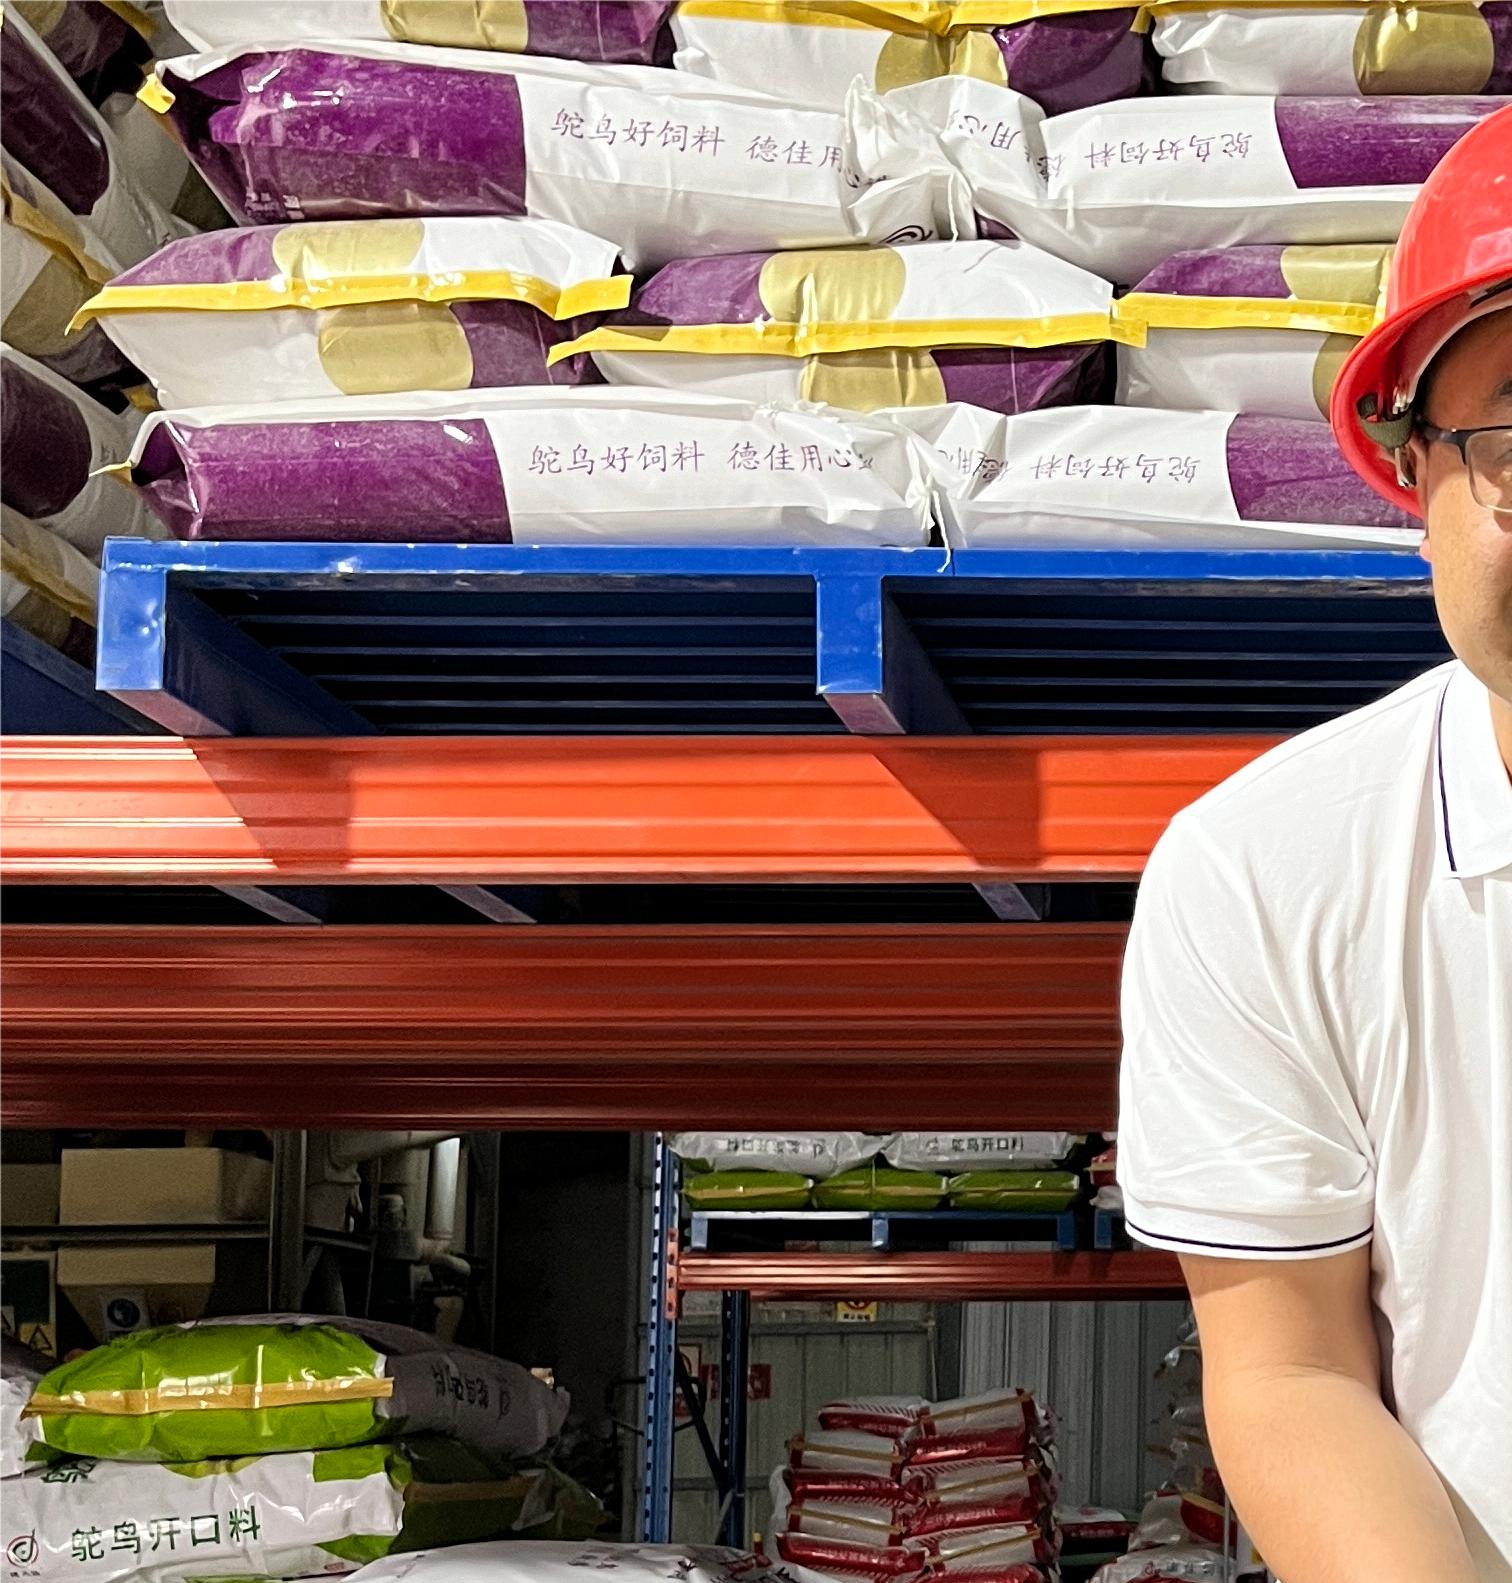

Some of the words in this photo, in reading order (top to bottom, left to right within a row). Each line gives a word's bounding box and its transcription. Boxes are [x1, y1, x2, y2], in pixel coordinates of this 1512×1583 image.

[551, 107, 726, 157] 鸵鸟好饲料
[1085, 131, 1253, 170] 鸵鸟好饲料
[528, 439, 705, 476] 鸵鸟好饲料
[1031, 453, 1201, 484] 鸵鸟好饲料
[71, 1505, 261, 1562] 鸵鸟开口料
